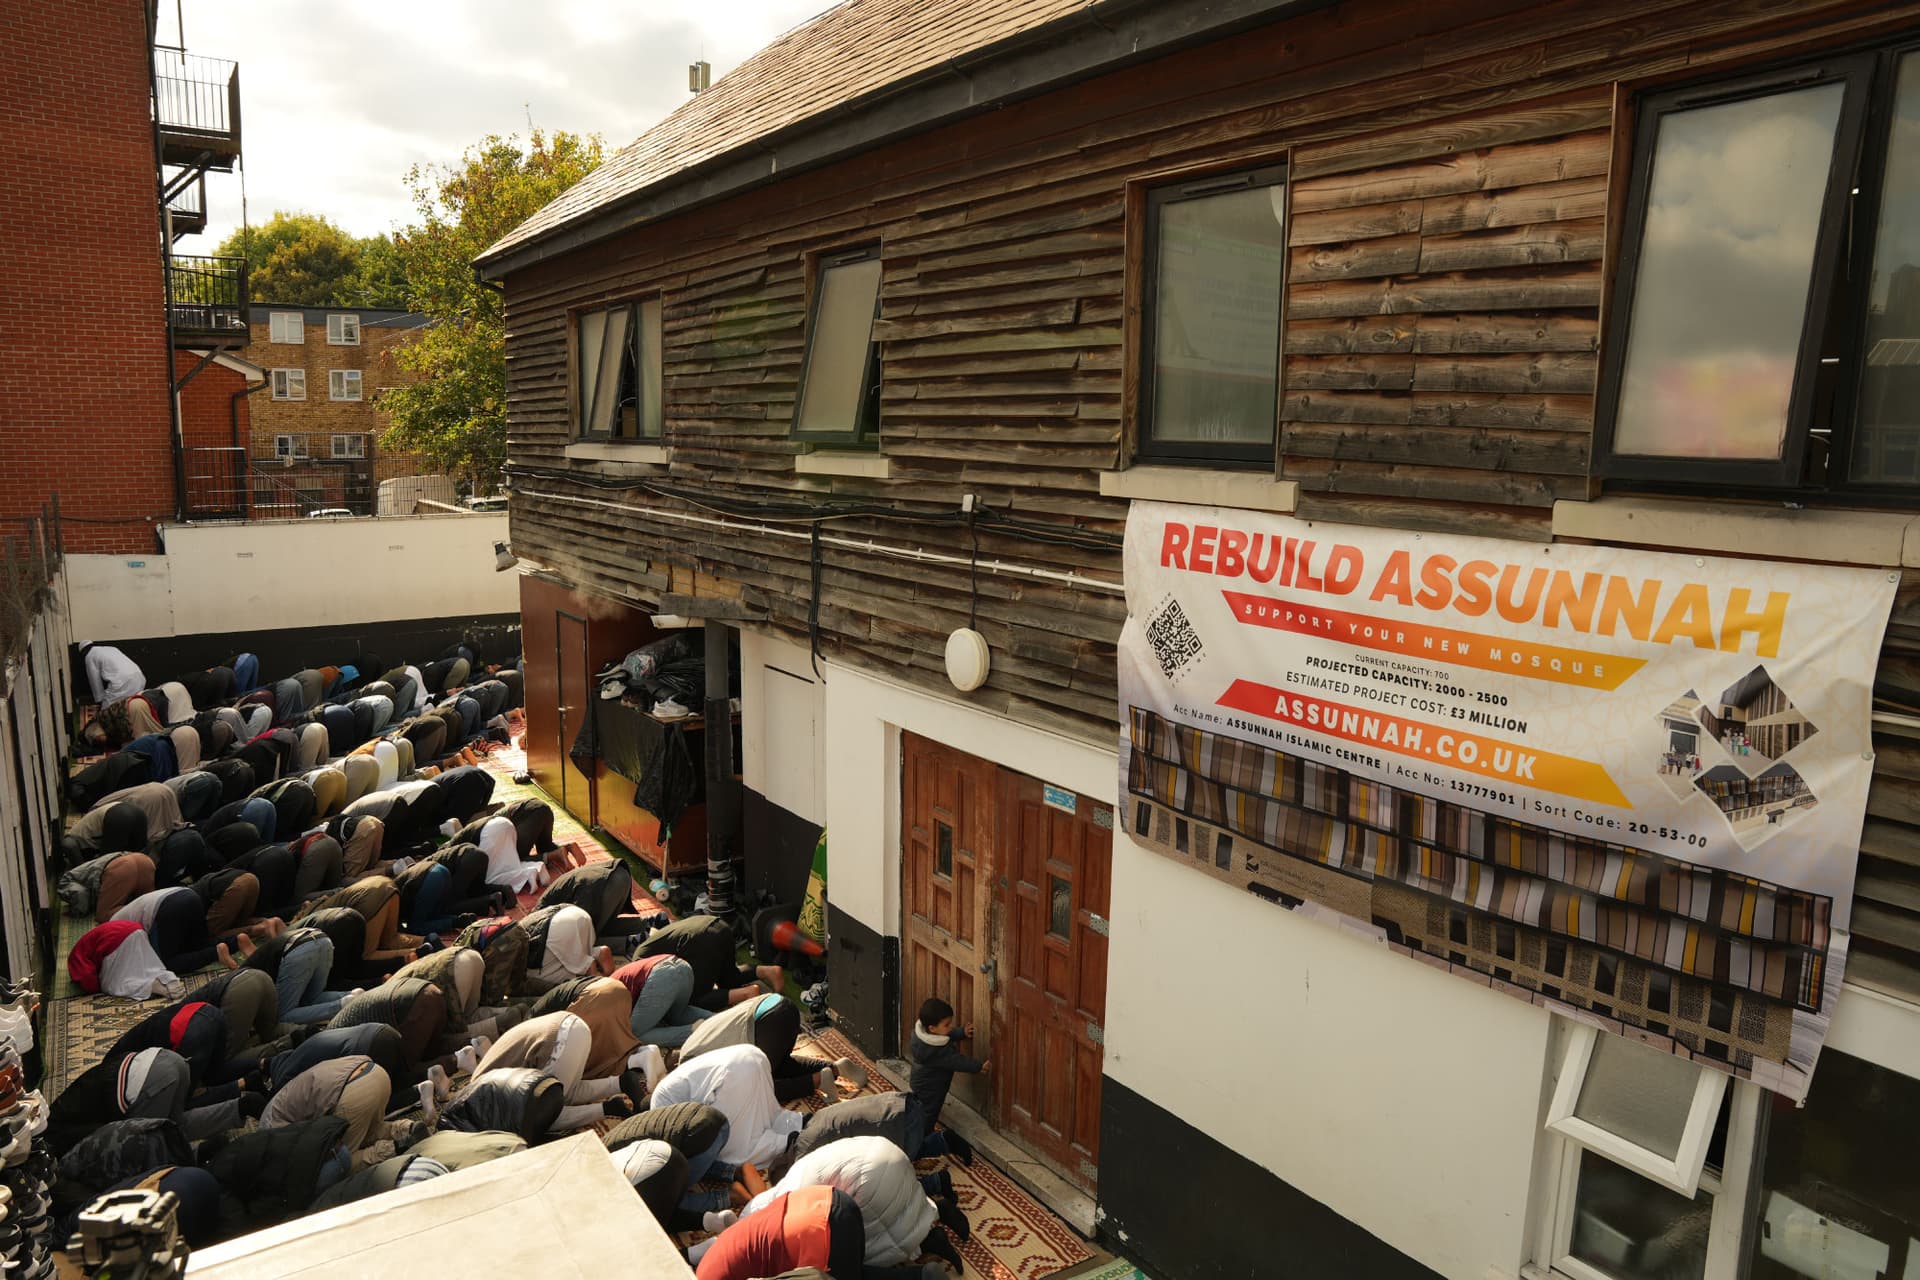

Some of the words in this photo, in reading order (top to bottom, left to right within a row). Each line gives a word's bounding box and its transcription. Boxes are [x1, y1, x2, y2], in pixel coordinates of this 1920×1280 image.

[1160, 522, 1364, 595] REBUILD
[1369, 549, 1791, 659] ASSUNNAH
[1245, 604, 1333, 630] SUPPORT
[1349, 623, 1405, 644] YOUR
[1423, 636, 1470, 655] NEW
[1490, 648, 1604, 678] MOSQUE
[1355, 654, 1389, 669] CURRENT
[1391, 662, 1433, 677] CAPACITY:
[1435, 670, 1450, 681] 700
[1286, 671, 1350, 694] ESTIMATED
[1353, 685, 1407, 707] PROJECT
[1410, 697, 1447, 716] COST:
[1450, 706, 1466, 720] £3
[1469, 710, 1528, 734] MILLION
[1305, 656, 1369, 677] PROJECTED
[1371, 669, 1433, 691] CAPACITY:
[1435, 683, 1465, 698] 2000
[1477, 691, 1508, 706] 2500
[1274, 694, 1537, 780] ASSUNNAH.CO.UK
[1173, 703, 1188, 717] Acc
[1191, 709, 1223, 725] Name:
[1226, 717, 1283, 741] ASSUNNAH
[1286, 733, 1332, 754] ISLAMIC
[1335, 748, 1381, 769] CENTRE
[1396, 764, 1419, 780] Acc
[1424, 772, 1445, 787] No:
[1450, 779, 1516, 805] 13777901
[1534, 800, 1567, 818] Sort
[1574, 809, 1622, 830] Code:
[1628, 821, 1707, 849] 20-53-00
